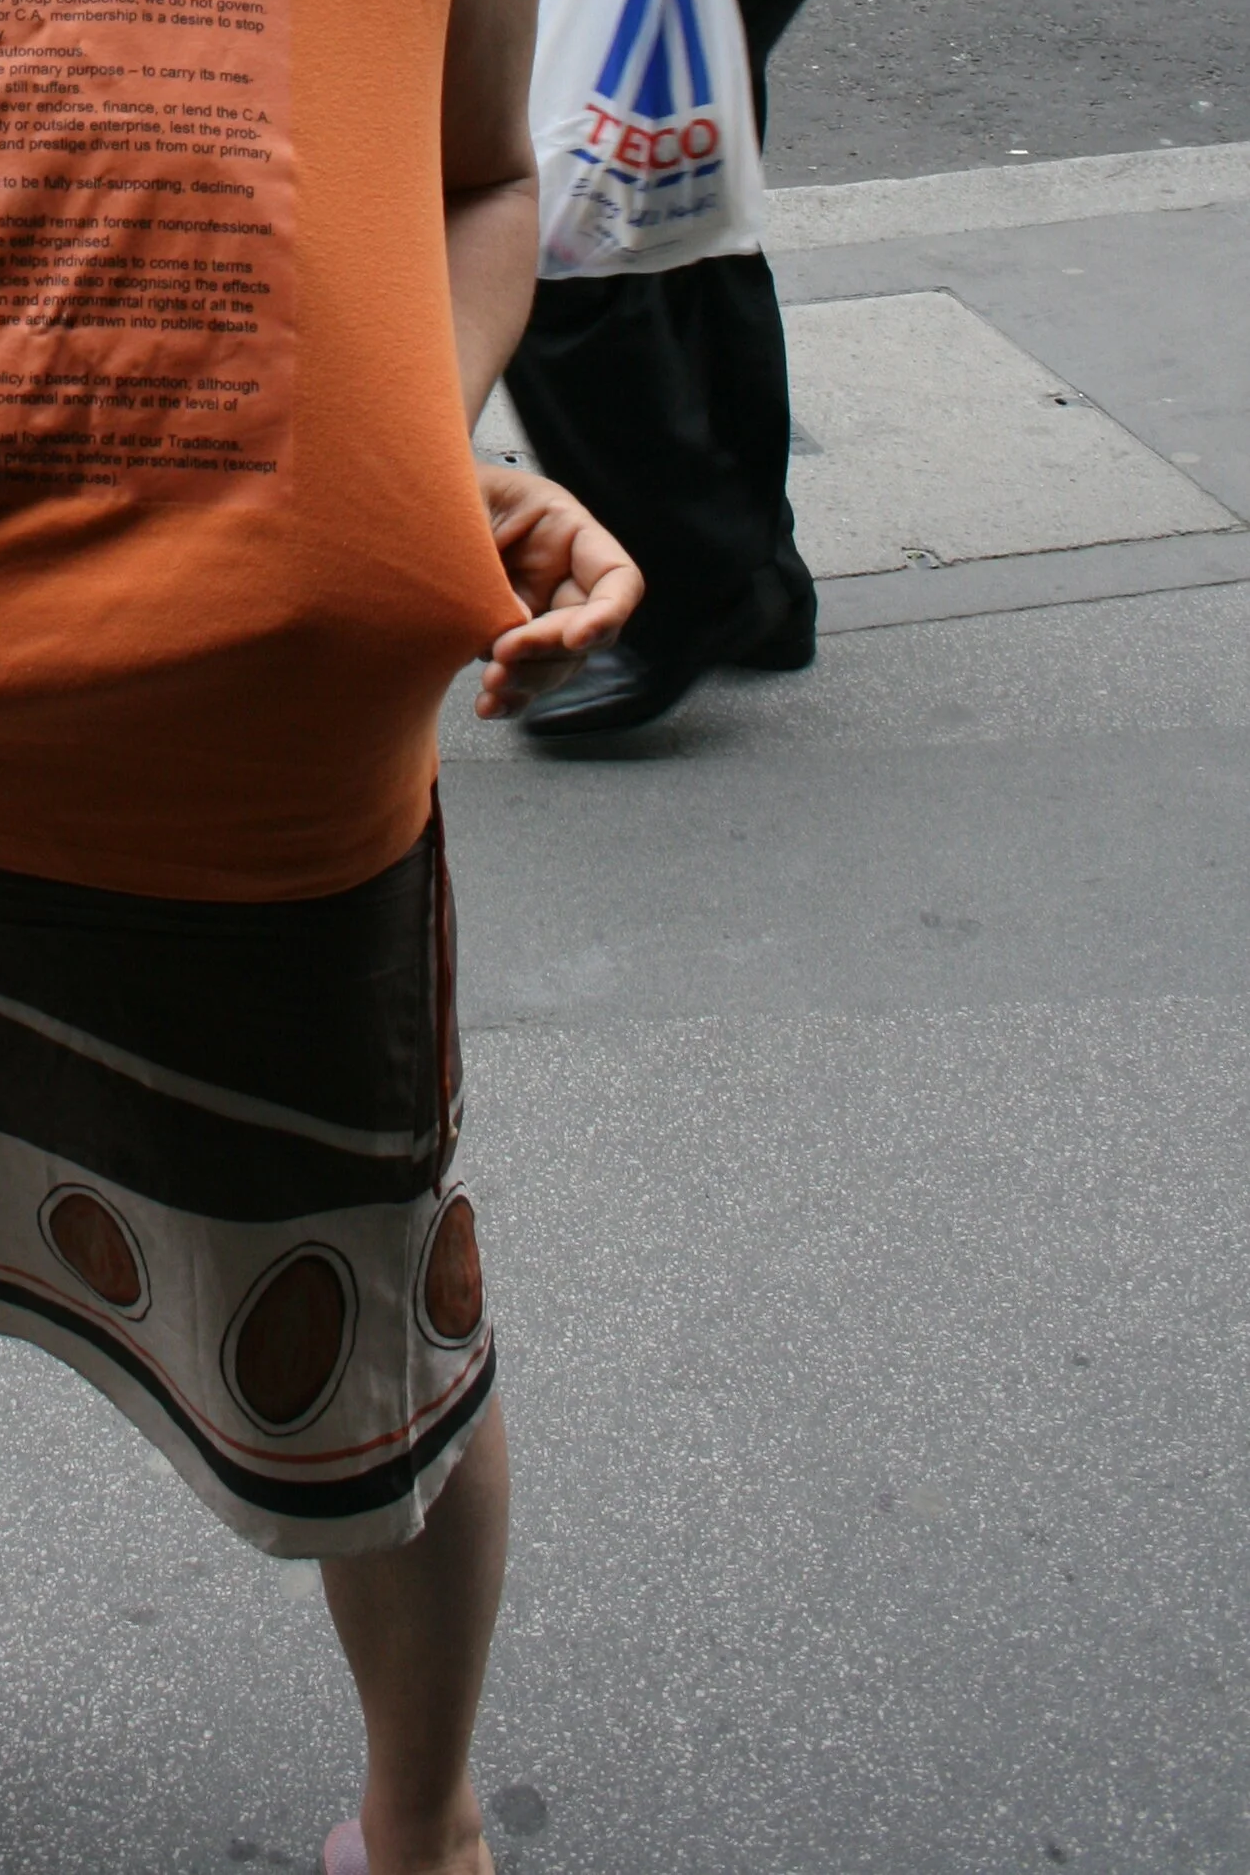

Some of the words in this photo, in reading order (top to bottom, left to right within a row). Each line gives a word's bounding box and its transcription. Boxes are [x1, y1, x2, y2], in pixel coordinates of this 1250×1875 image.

[51, 9, 137, 23] membership
[142, 9, 152, 21] is
[158, 13, 166, 22] a
[171, 12, 213, 25] desire
[218, 15, 231, 27] to
[236, 18, 264, 33] stop
[9, 63, 62, 77] primary
[67, 65, 124, 77] purpose
[142, 65, 155, 76] to
[160, 67, 195, 80] carry
[200, 67, 215, 79] its
[5, 81, 28, 92] still
[163, 104, 178, 113] or
[183, 102, 211, 115] lend
[217, 106, 238, 118] the
[15, 120, 29, 130] or
[34, 118, 84, 130] outside
[170, 121, 195, 133] lest
[200, 123, 221, 135] the
[90, 138, 129, 150] divert
[134, 141, 150, 150] us
[155, 138, 187, 151] from
[193, 143, 216, 153] our
[220, 144, 272, 162] primary
[3, 177, 17, 187] to
[22, 176, 39, 188] be
[190, 179, 255, 196] declining
[150, 259, 189, 269] come
[212, 260, 253, 272] terms
[222, 279, 270, 293] effects
[210, 298, 226, 310] all
[82, 313, 126, 326] drawn
[131, 315, 156, 328] into
[161, 317, 203, 331] public
[197, 378, 259, 395] although
[186, 397, 218, 410] level
[223, 458, 277, 474] (except
